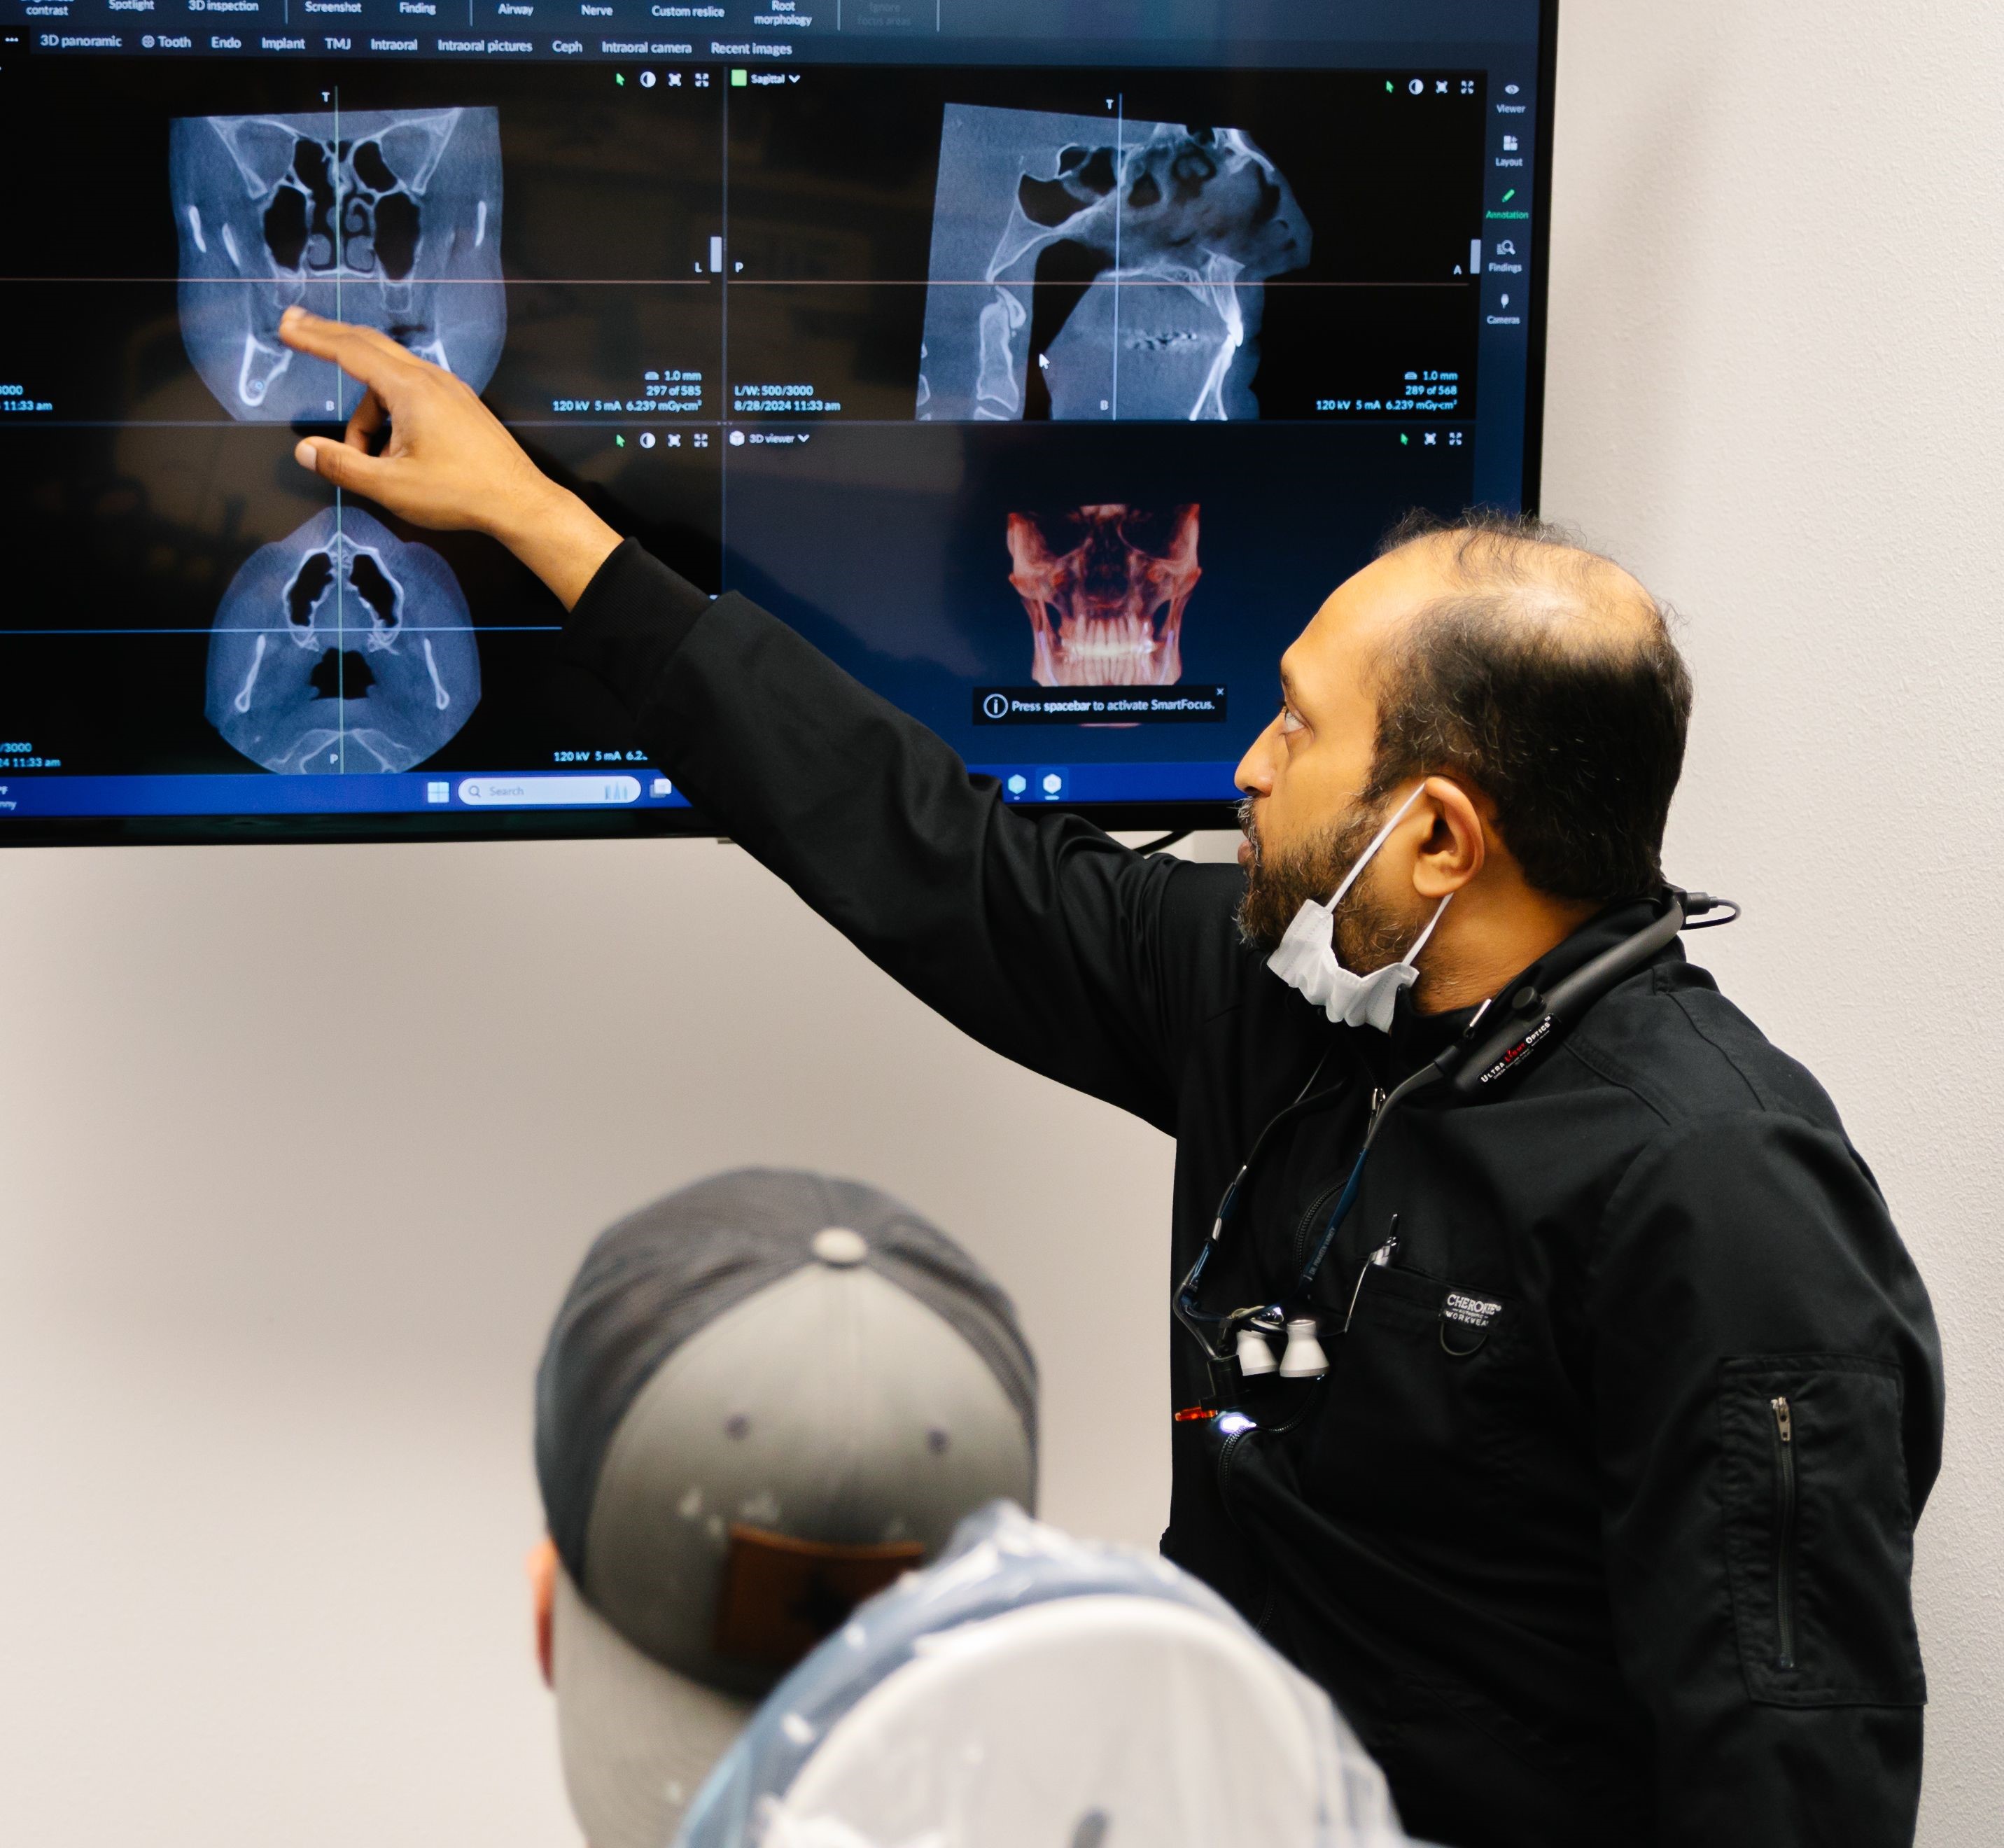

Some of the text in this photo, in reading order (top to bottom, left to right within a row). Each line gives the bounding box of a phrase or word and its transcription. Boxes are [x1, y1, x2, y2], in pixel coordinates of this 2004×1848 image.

[26, 6, 69, 15] contrast
[109, 0, 155, 11] Spotlight
[188, 0, 259, 13] 3D inspection
[305, 1, 362, 13] Screenshot
[400, 2, 436, 15] Finding
[498, 4, 533, 16] Airway
[581, 5, 613, 16] Nerve
[772, 1, 795, 11] Root
[652, 6, 725, 18] Custom reslice
[754, 14, 812, 27] morphology
[40, 34, 122, 48] 3D panoramic
[157, 36, 192, 48] Tooth
[211, 36, 241, 48] Endo
[262, 37, 305, 51] Implant
[324, 38, 351, 50] TMJ
[371, 38, 418, 50] Intraoral
[437, 39, 533, 53] Intraoral pictures
[552, 41, 583, 54] Ceph
[602, 41, 692, 54] Intraoral camera
[711, 42, 792, 57] Recent images
[750, 74, 785, 85] Sagittal
[321, 92, 330, 102] T
[1106, 99, 1114, 110] T
[1496, 104, 1526, 114] Viewer
[1495, 158, 1523, 168] Layout
[1485, 210, 1529, 220] Annotation
[694, 262, 702, 272] L
[735, 262, 744, 273] P
[1453, 265, 1462, 275] A
[1488, 262, 1522, 274] Findings
[1487, 315, 1520, 325] Cameras
[664, 370, 702, 381] 1.0 mm
[1423, 370, 1458, 381] 1.0 mm
[645, 385, 667, 396] 297
[668, 385, 680, 396] of
[734, 385, 814, 396] L/W: 500/3000
[1406, 386, 1457, 396] 289 of 568
[3, 400, 52, 411] 11:33 am
[325, 400, 335, 412] B
[552, 400, 574, 411] 120
[575, 400, 590, 411] kV
[594, 400, 602, 411] 5
[603, 400, 622, 411] mA
[626, 400, 656, 412] 6.239
[734, 400, 841, 411] 8/28/2024 11:33 am
[1316, 400, 1336, 410] 120
[1337, 400, 1351, 410] kV
[1356, 400, 1362, 410] 5
[1364, 400, 1381, 410] mA
[1385, 400, 1413, 410] 6.239
[749, 433, 795, 444] 3D viewer
[1012, 699, 1215, 713] Press spacebar to activate SmartFocus.
[330, 753, 339, 764] P
[554, 751, 575, 762] 120
[575, 750, 590, 761] kV
[595, 750, 602, 761] 5
[603, 750, 622, 761] mA
[13, 757, 43, 767] 11:33
[489, 785, 524, 797] Search
[1480, 1062, 1505, 1083] ULTRA
